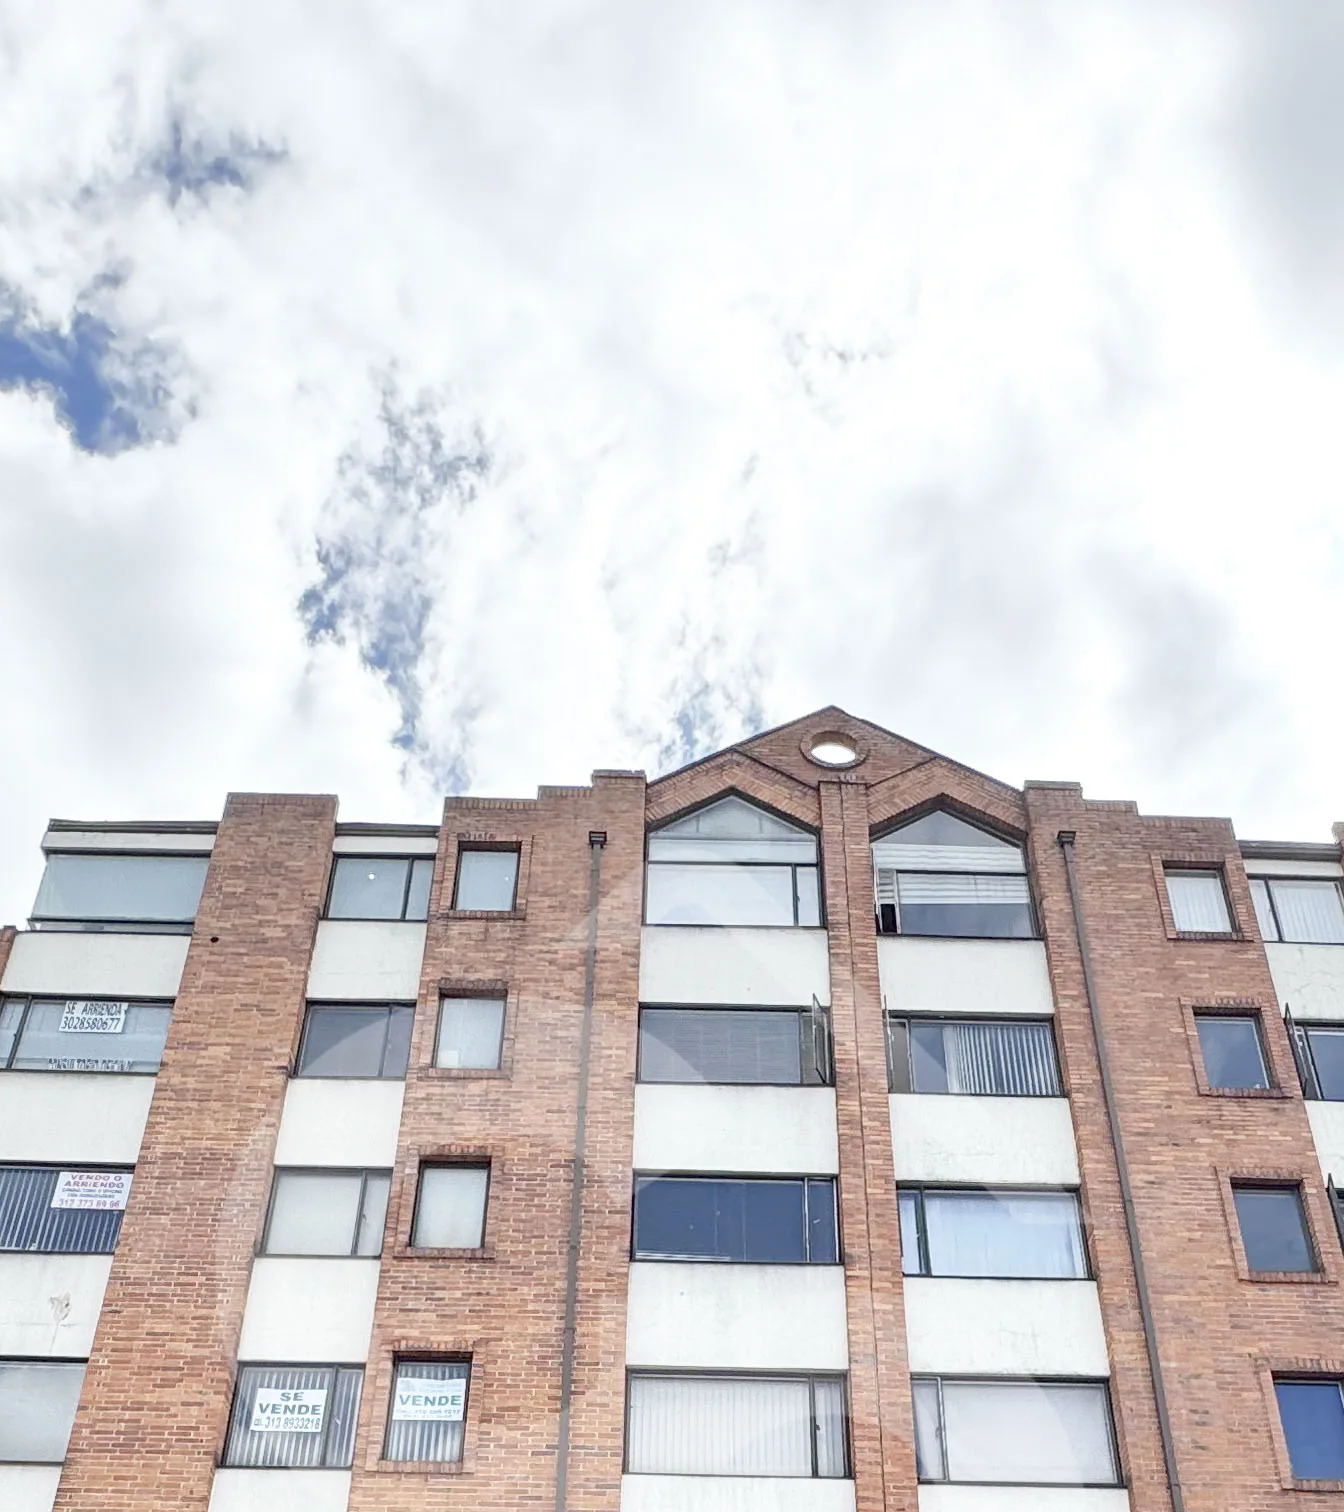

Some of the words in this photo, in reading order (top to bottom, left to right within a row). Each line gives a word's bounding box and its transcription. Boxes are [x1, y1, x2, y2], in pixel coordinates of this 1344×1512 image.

[280, 1392, 304, 1401] SE
[399, 1394, 462, 1406] VENDE
[259, 1403, 323, 1415] VENDE
